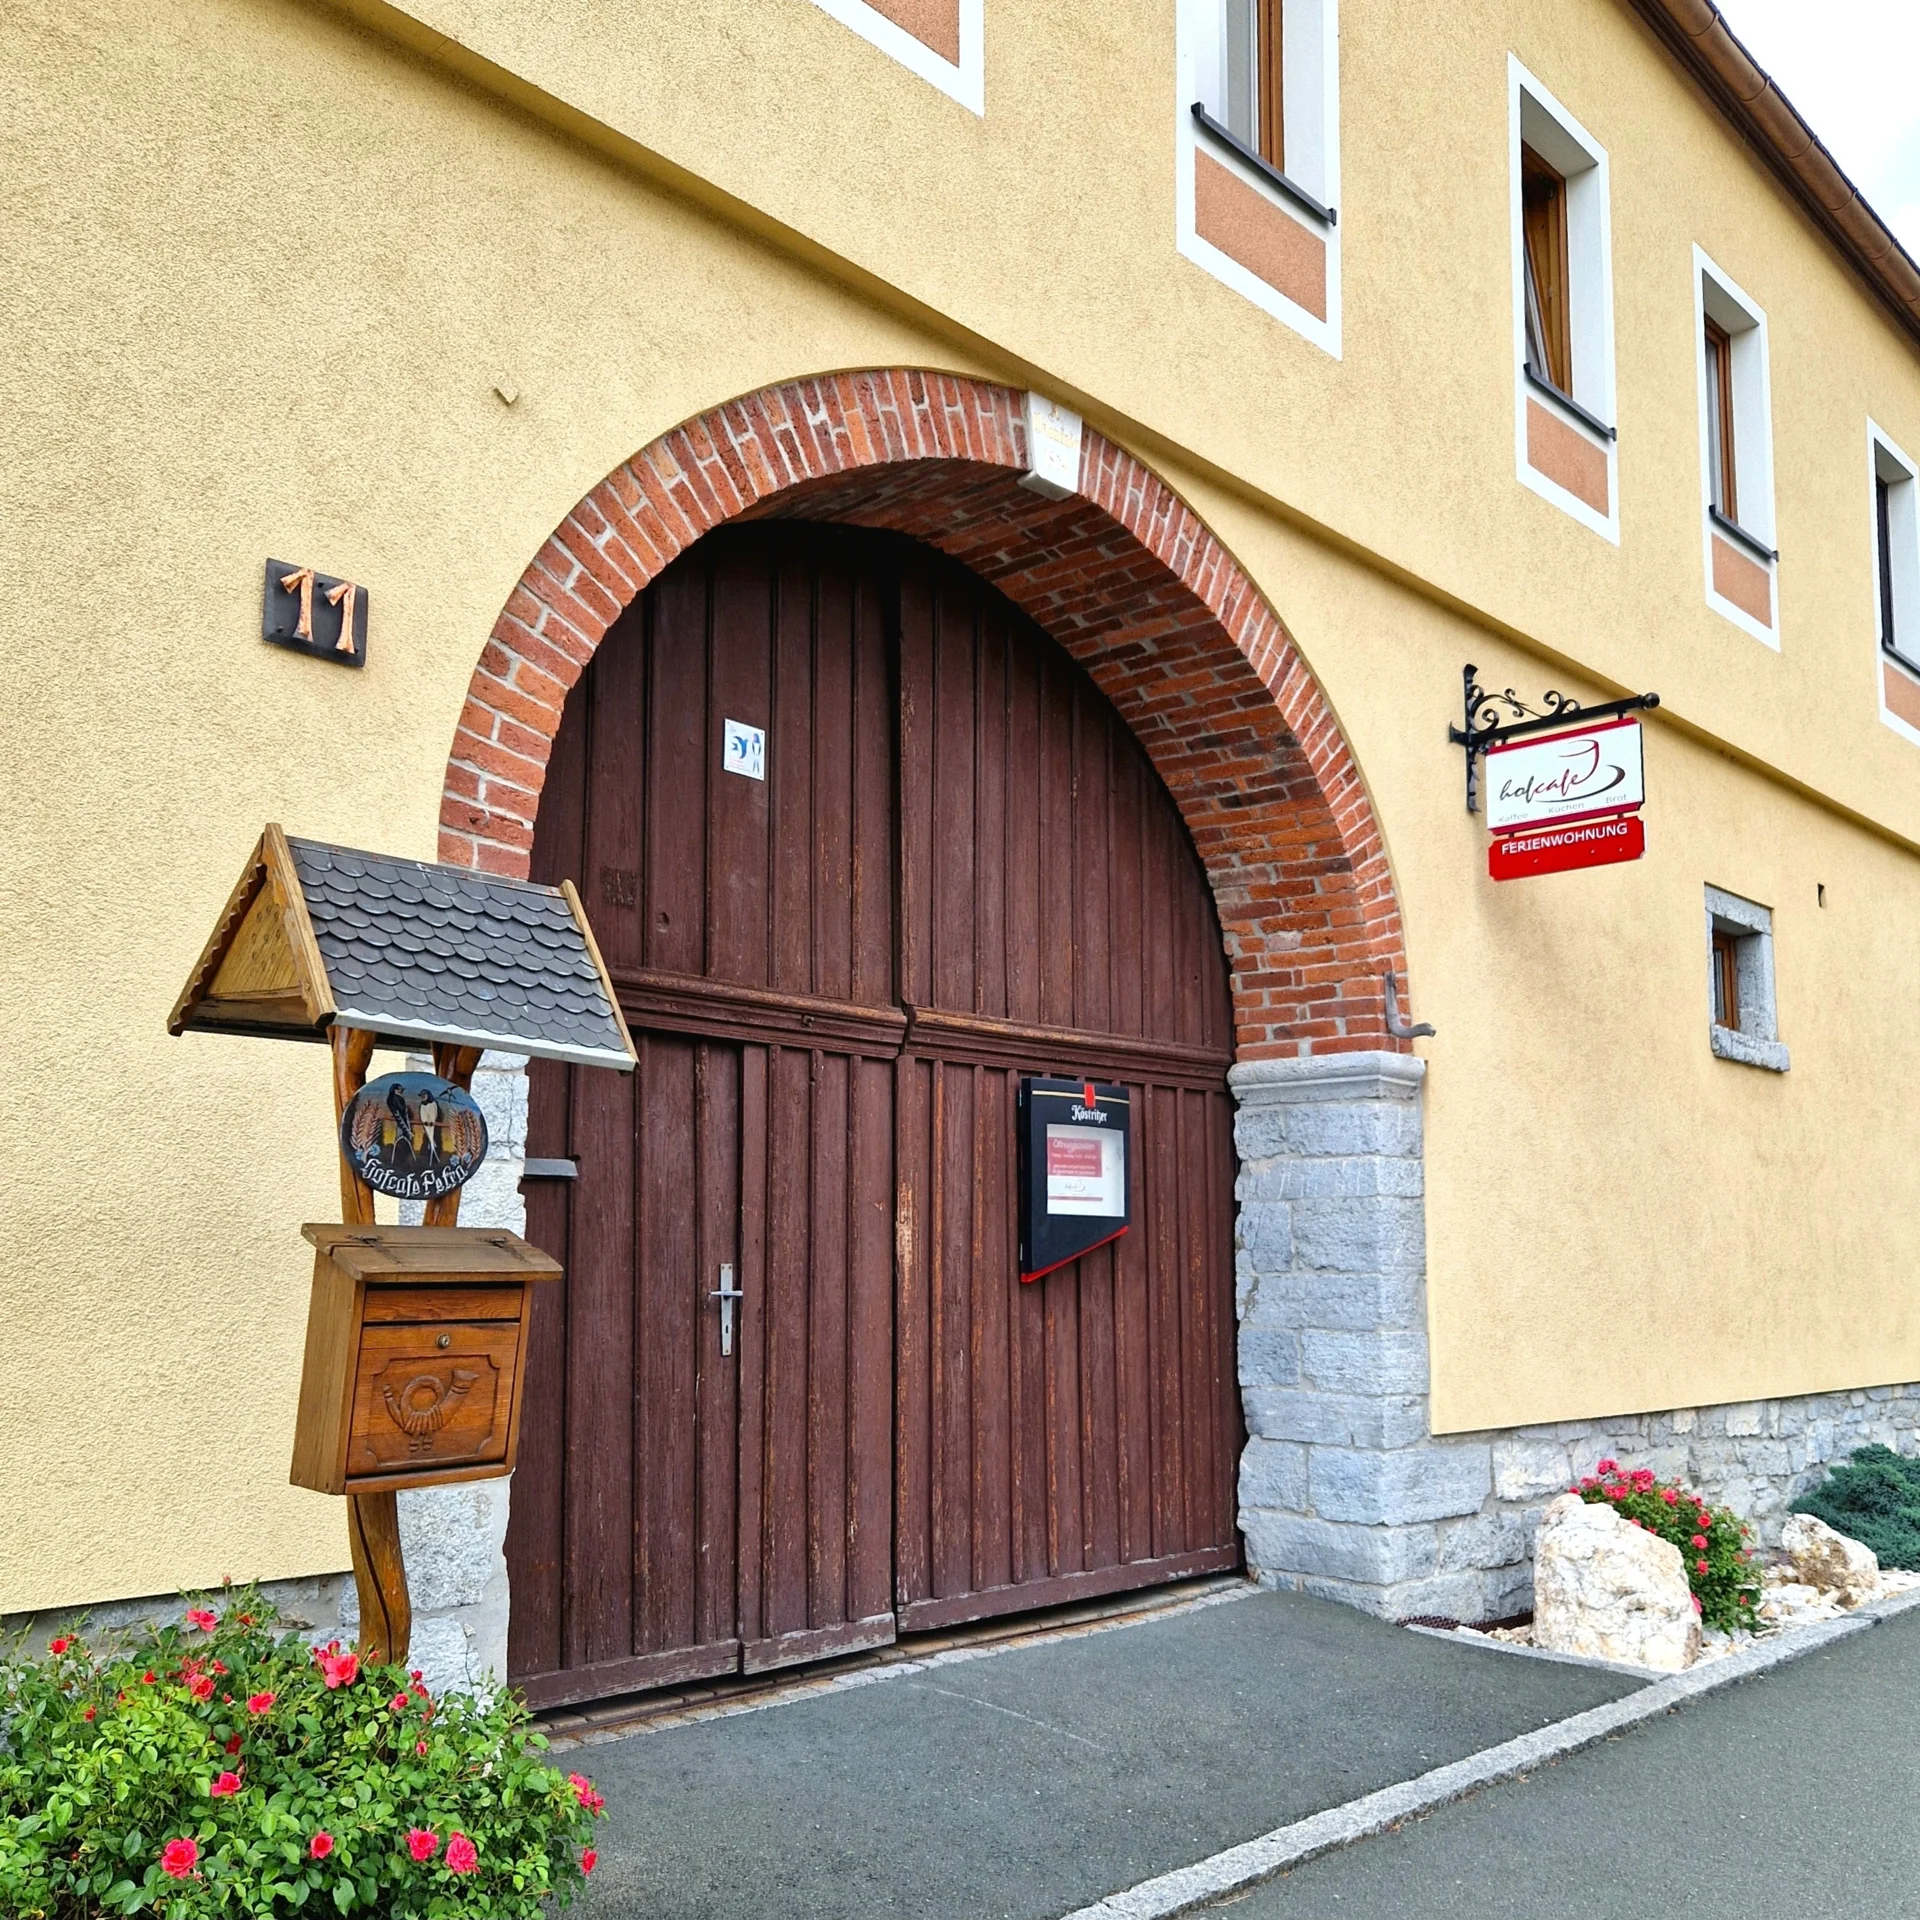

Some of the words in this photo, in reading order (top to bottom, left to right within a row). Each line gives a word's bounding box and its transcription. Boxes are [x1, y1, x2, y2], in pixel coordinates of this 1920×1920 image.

[280, 568, 356, 655] 11
[1499, 768, 1582, 804] hofcafe
[1498, 811, 1529, 823] Kaffee
[1605, 793, 1628, 804] Brot
[1501, 822, 1628, 855] FERIENWOHNUNG
[1071, 1104, 1108, 1124] Köstritzer
[420, 1165, 468, 1196] Petra
